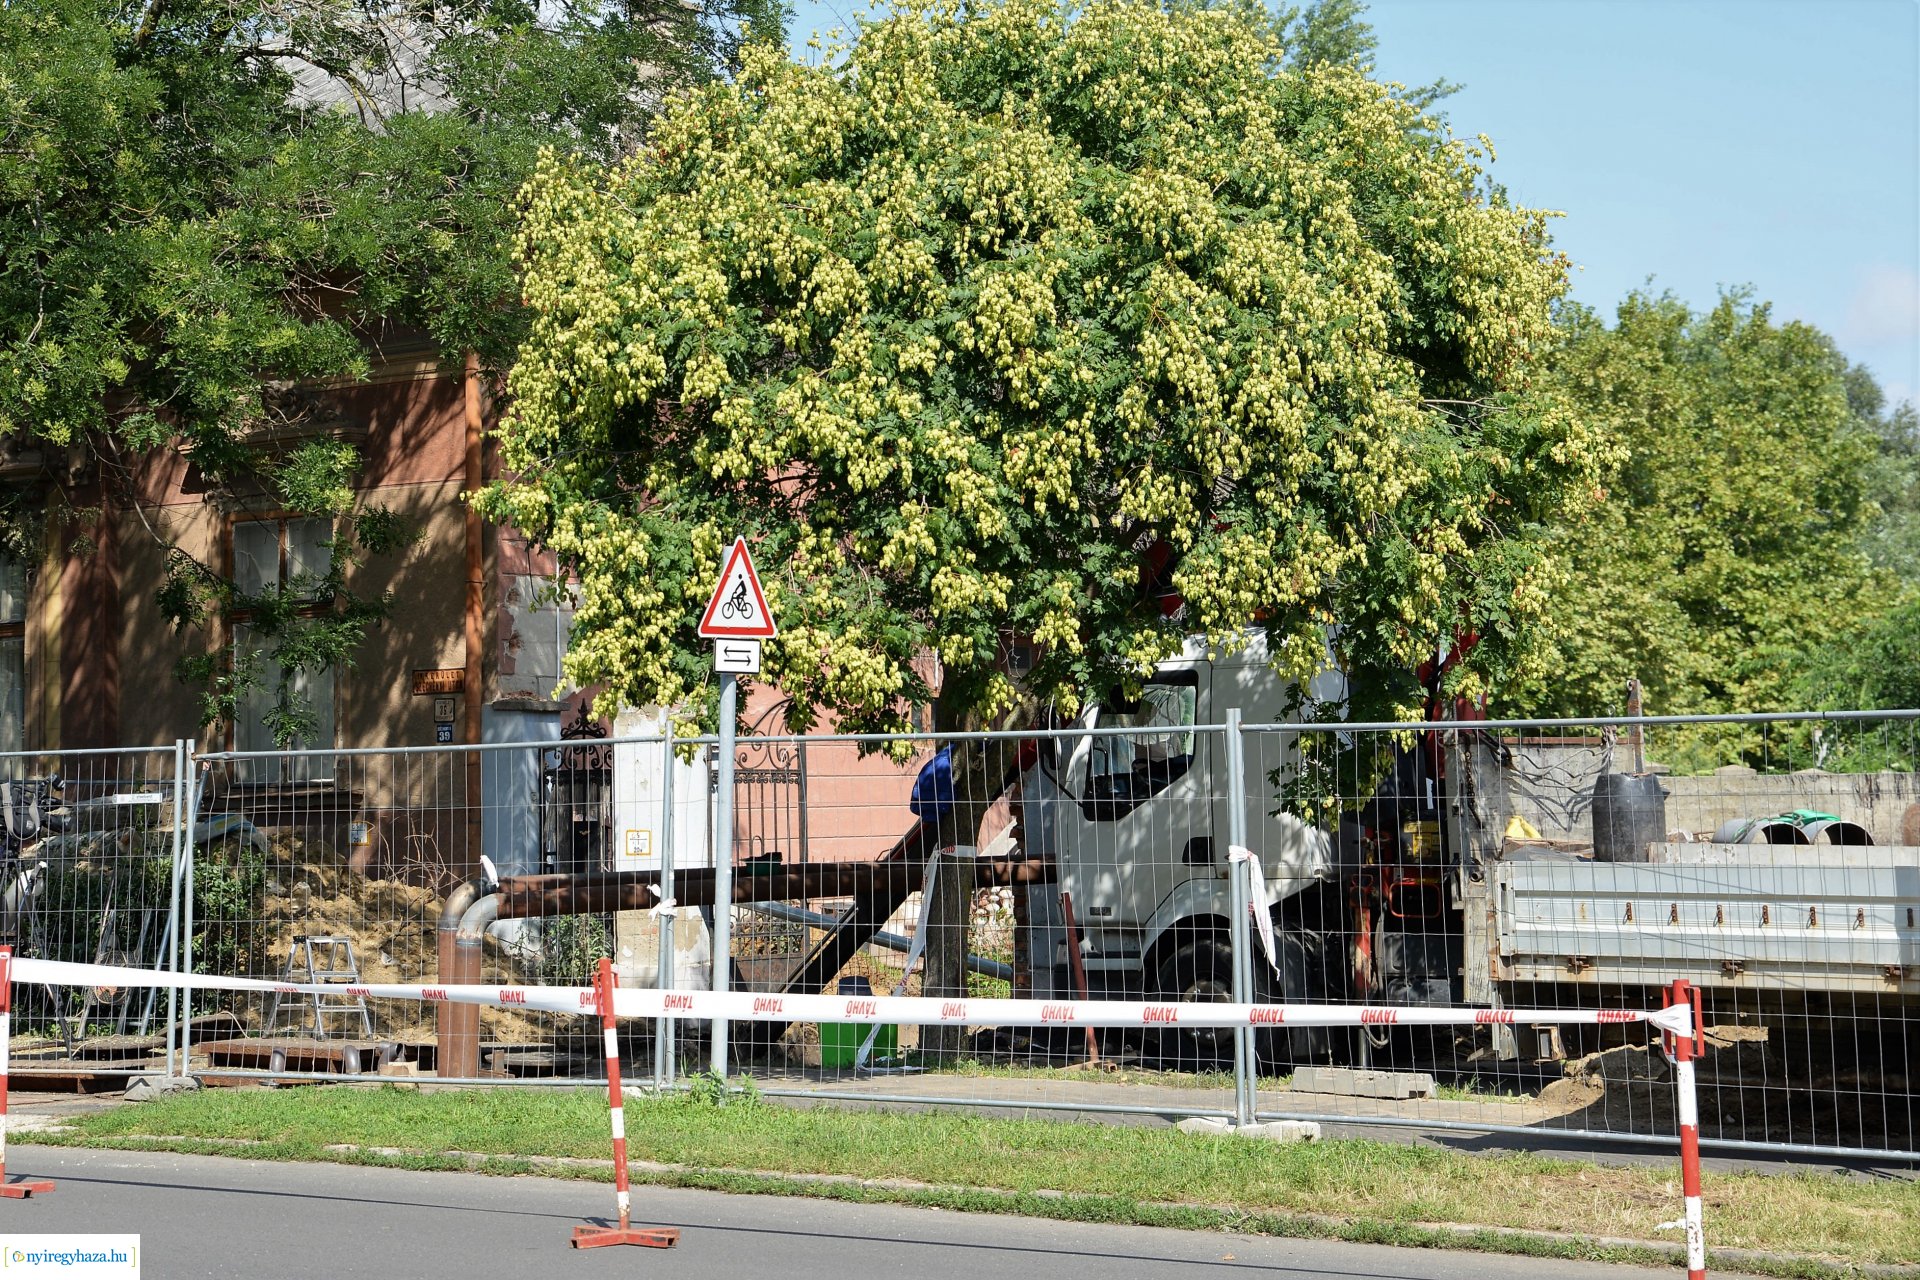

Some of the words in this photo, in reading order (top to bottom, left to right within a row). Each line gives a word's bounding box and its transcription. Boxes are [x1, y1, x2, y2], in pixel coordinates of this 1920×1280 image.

[439, 731, 451, 741] 39
[663, 994, 693, 1012] TÁVHŐ
[752, 997, 783, 1015] TÁVHŐ
[845, 1000, 876, 1018] TÁVHŐ
[1041, 1004, 1075, 1023] TÁVHŐ
[1143, 1006, 1178, 1024] TÁVHŐ
[1249, 1008, 1285, 1025] TÁVHŐ
